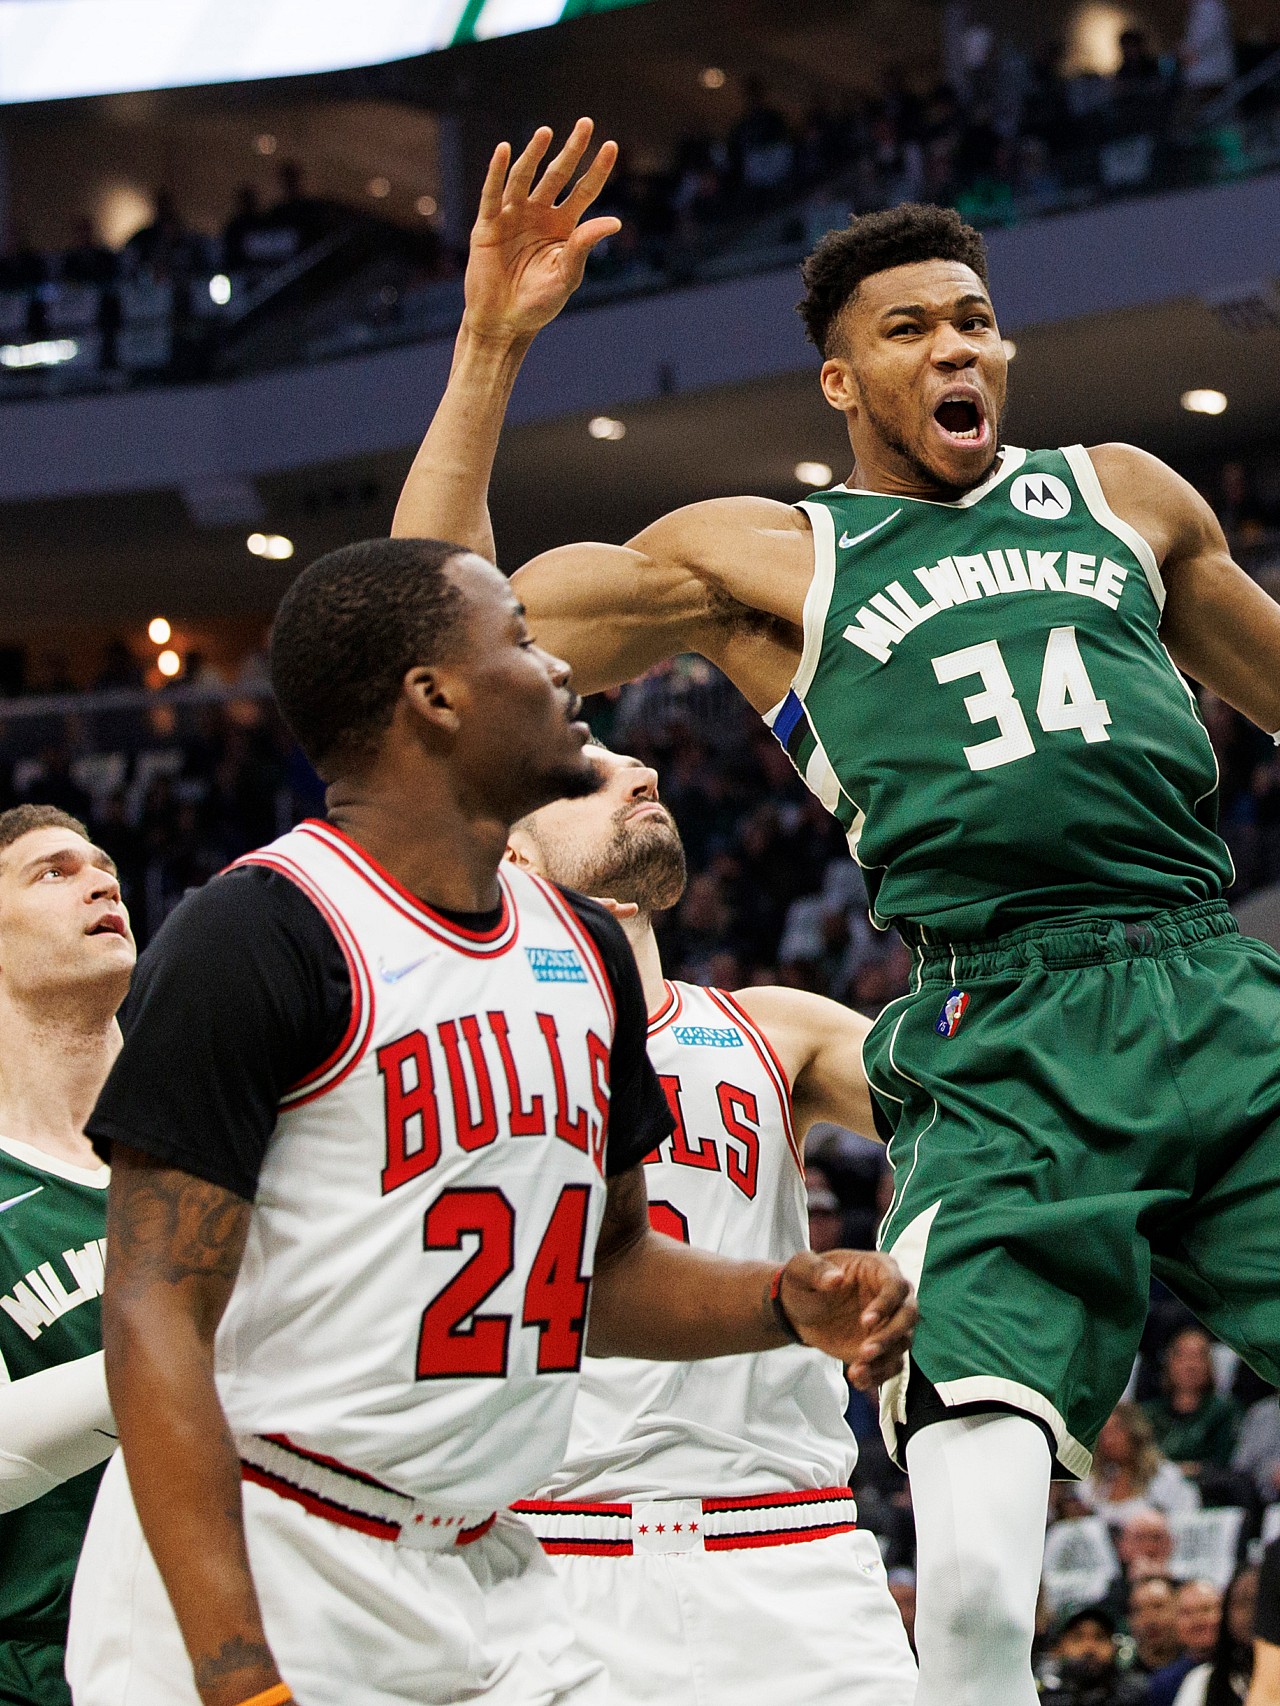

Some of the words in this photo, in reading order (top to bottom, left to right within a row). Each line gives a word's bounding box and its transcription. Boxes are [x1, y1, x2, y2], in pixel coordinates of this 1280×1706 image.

[842, 548, 1128, 664] MILWAUKEE
[931, 625, 1112, 771] 34
[677, 1037, 741, 1047] EYEWEAR
[415, 1183, 592, 1381] 24
